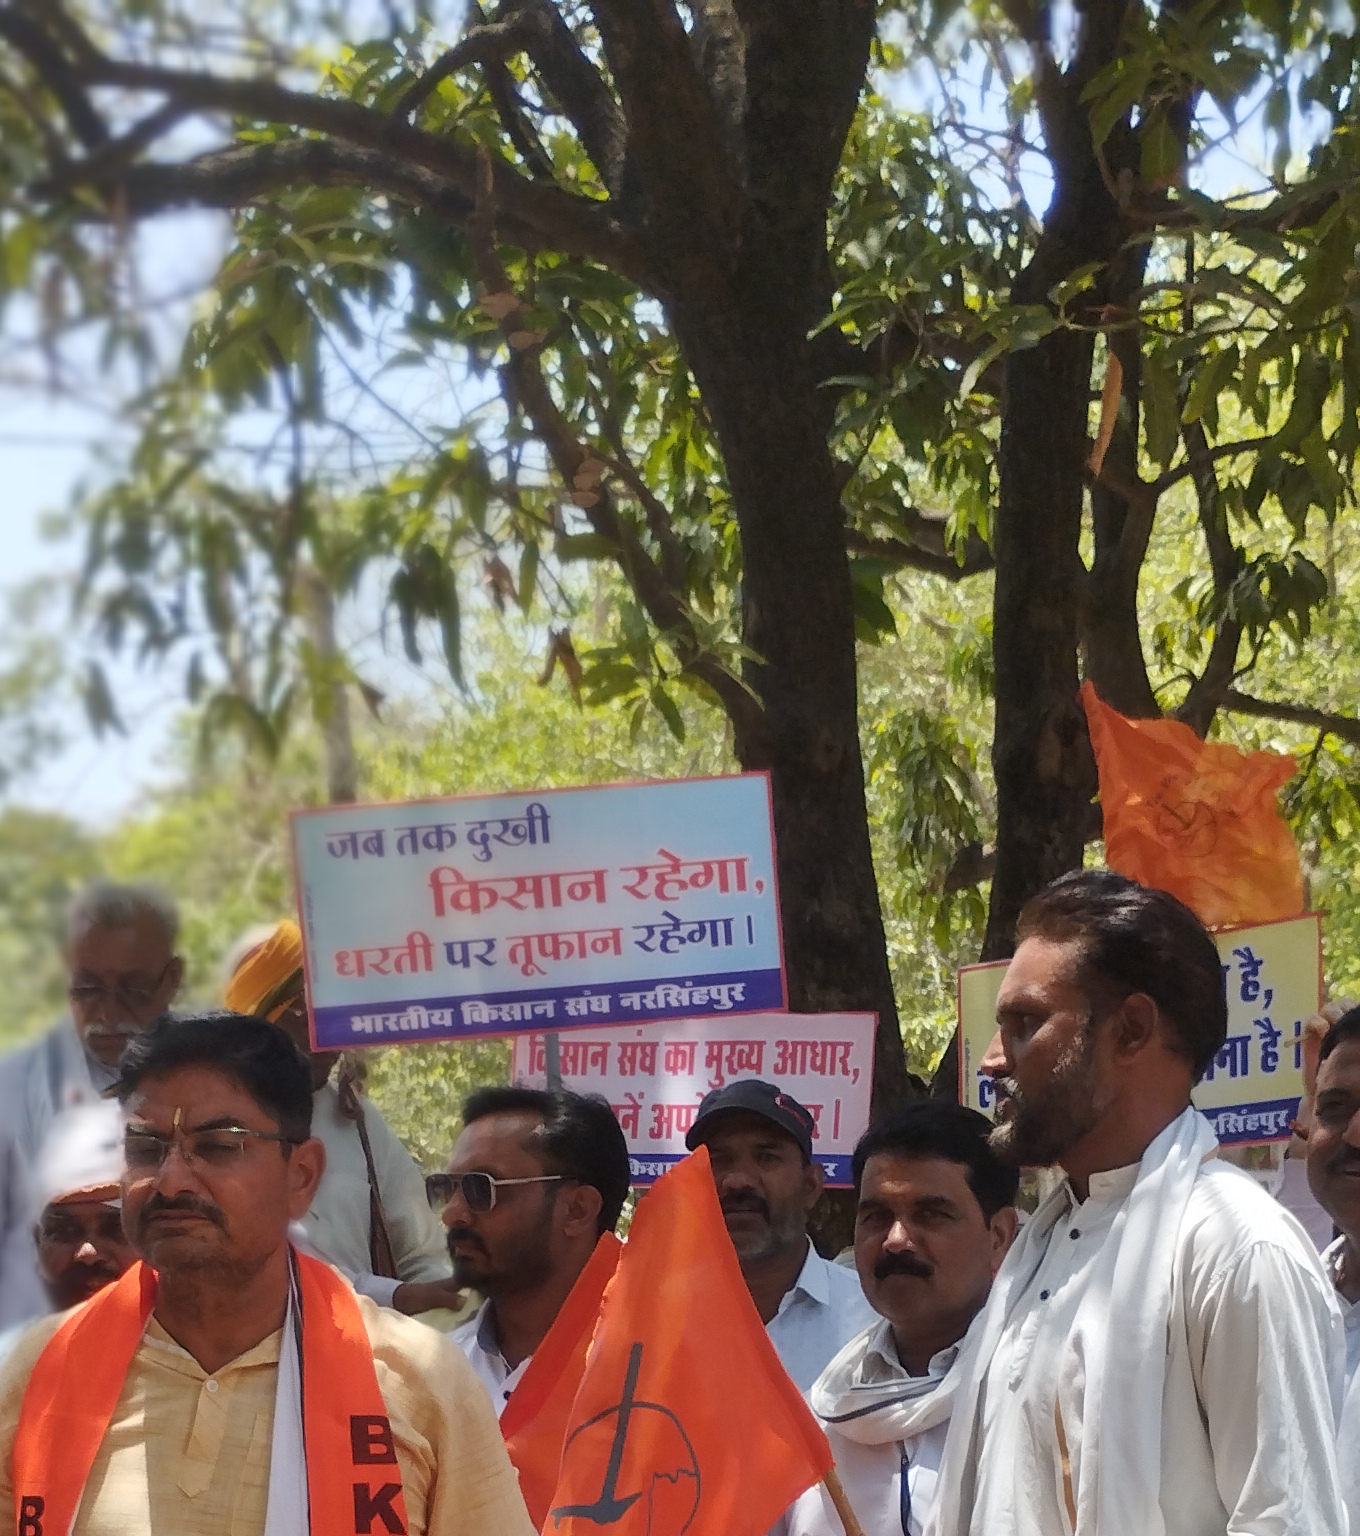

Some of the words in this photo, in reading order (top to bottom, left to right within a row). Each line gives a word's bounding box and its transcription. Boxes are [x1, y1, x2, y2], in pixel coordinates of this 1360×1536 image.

[325, 828, 385, 860] जब
[395, 821, 457, 856] तक
[465, 802, 551, 863] दुखी
[427, 866, 609, 918] किसान
[334, 931, 435, 978] धरती
[443, 938, 497, 969] पर
[505, 926, 624, 976] तूफान
[349, 1006, 454, 1034] भारतीय
[461, 1000, 556, 1025] किसान
[564, 989, 612, 1017] संघ
[619, 980, 746, 1011] नरसिंहपुर
[618, 1029, 658, 1077] संघ
[664, 1041, 698, 1076] का
[705, 1040, 766, 1087] मुख्य
